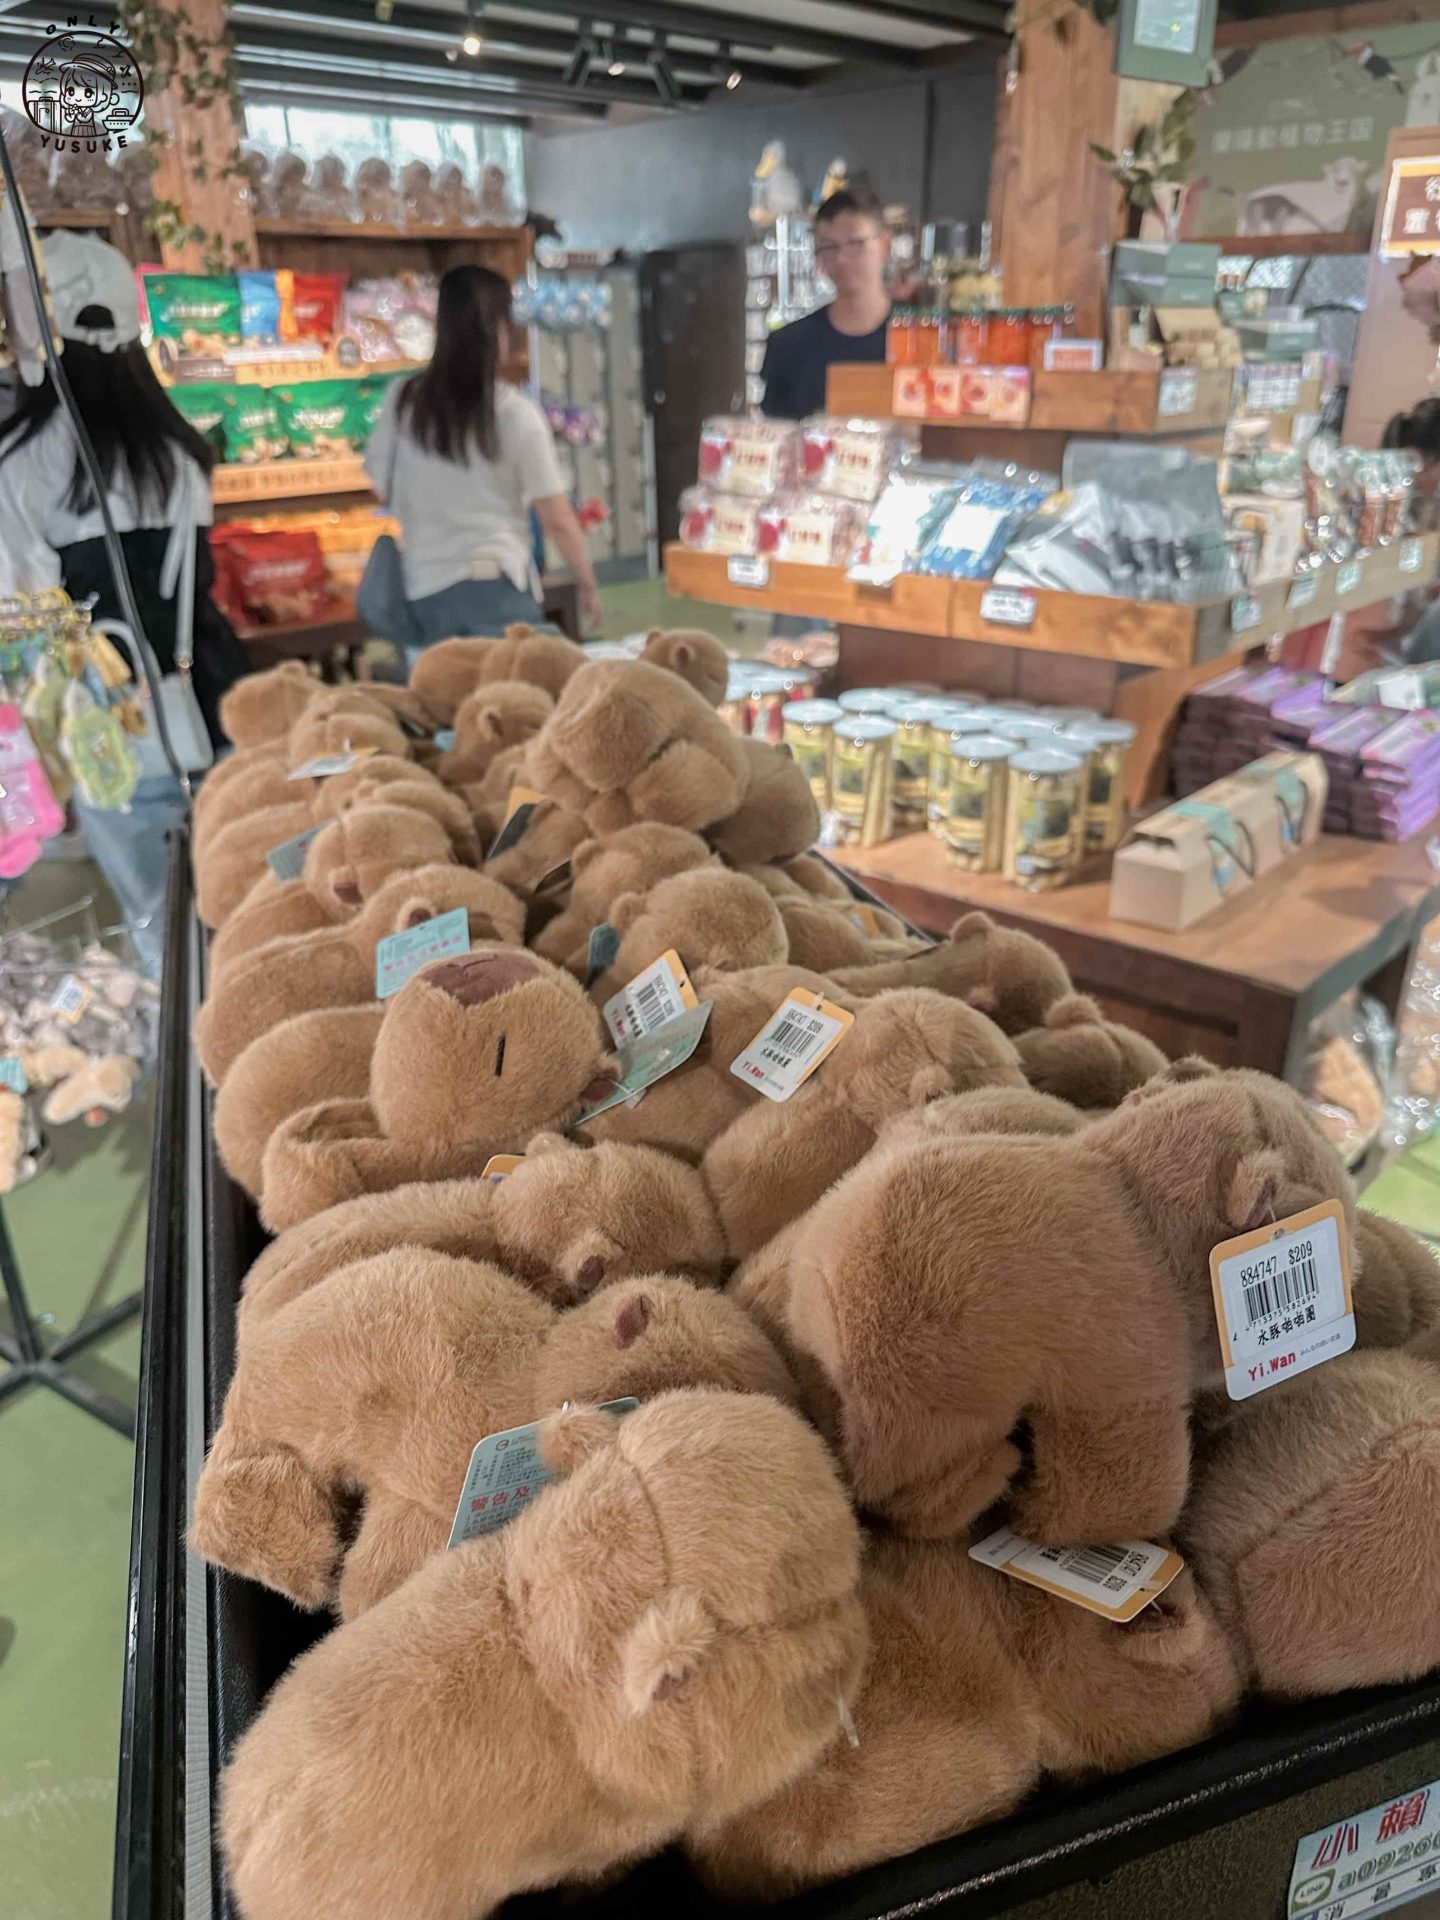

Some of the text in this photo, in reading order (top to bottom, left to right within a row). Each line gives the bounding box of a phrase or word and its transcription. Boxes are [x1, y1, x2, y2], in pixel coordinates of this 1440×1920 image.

[1240, 1240, 1313, 1287] 884747 $209
[1248, 1352, 1296, 1381] Yi.Wan
